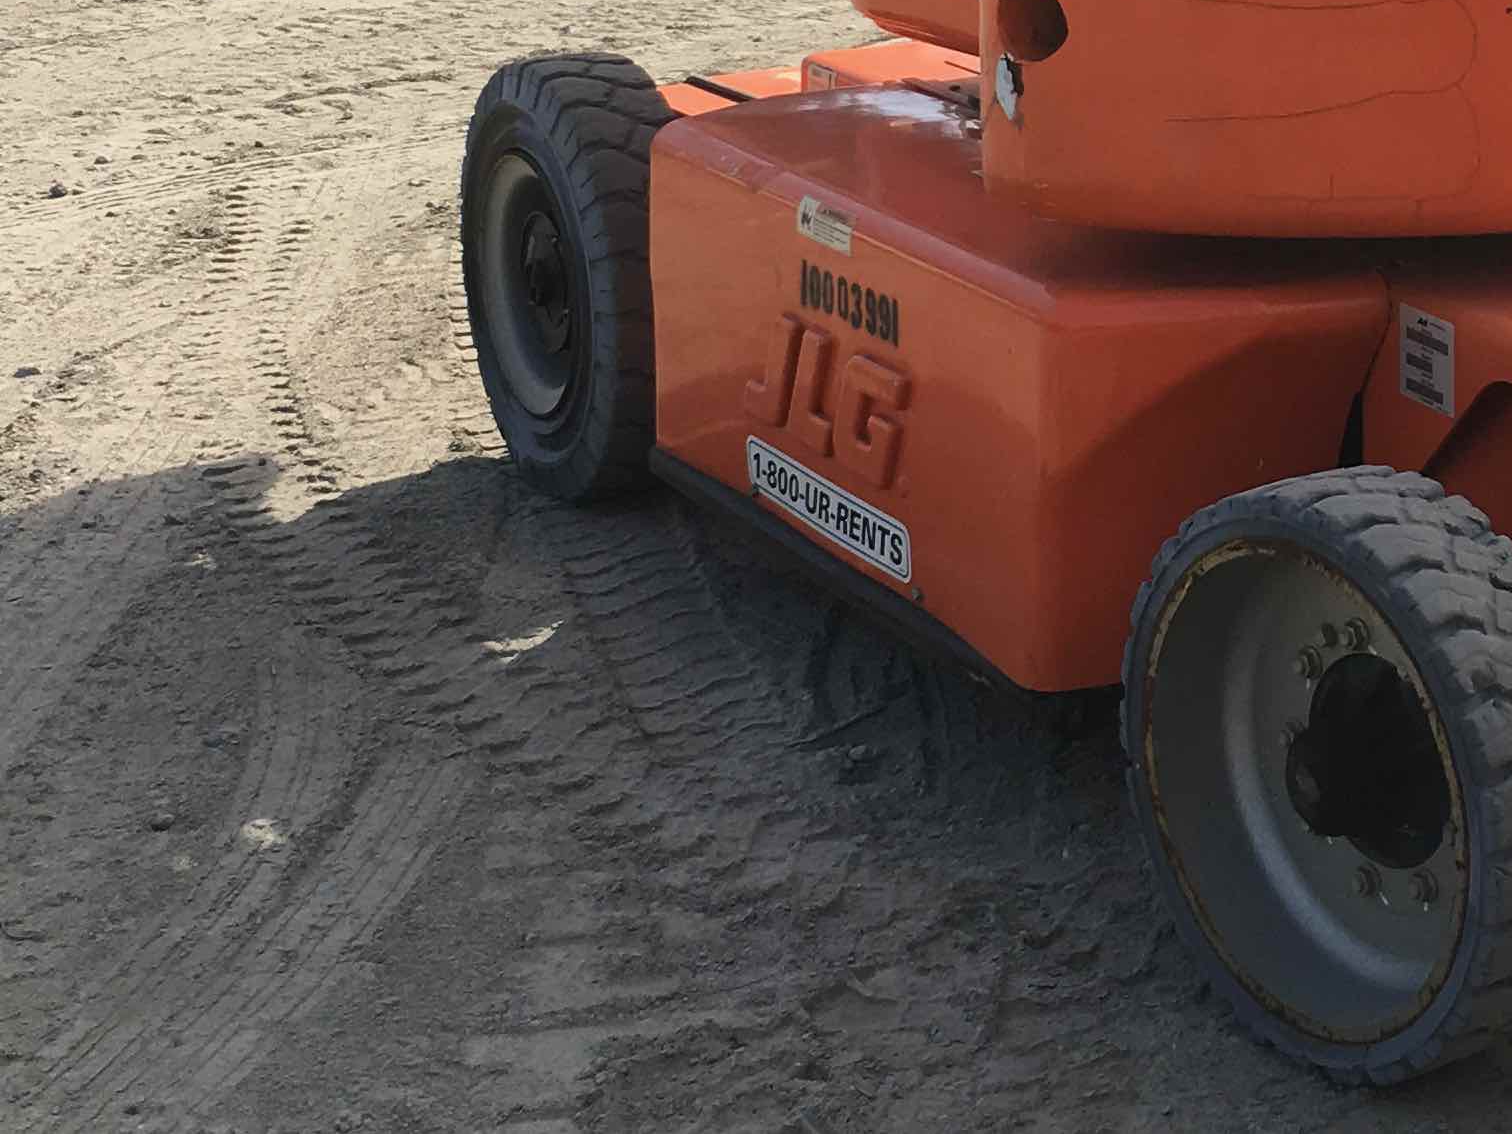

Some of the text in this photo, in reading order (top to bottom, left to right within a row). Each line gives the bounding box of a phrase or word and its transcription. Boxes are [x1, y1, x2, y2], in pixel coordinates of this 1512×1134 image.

[800, 259, 900, 347] 10003991
[745, 311, 913, 492] JLG
[753, 452, 903, 567] 1-800-UR-RENTS
